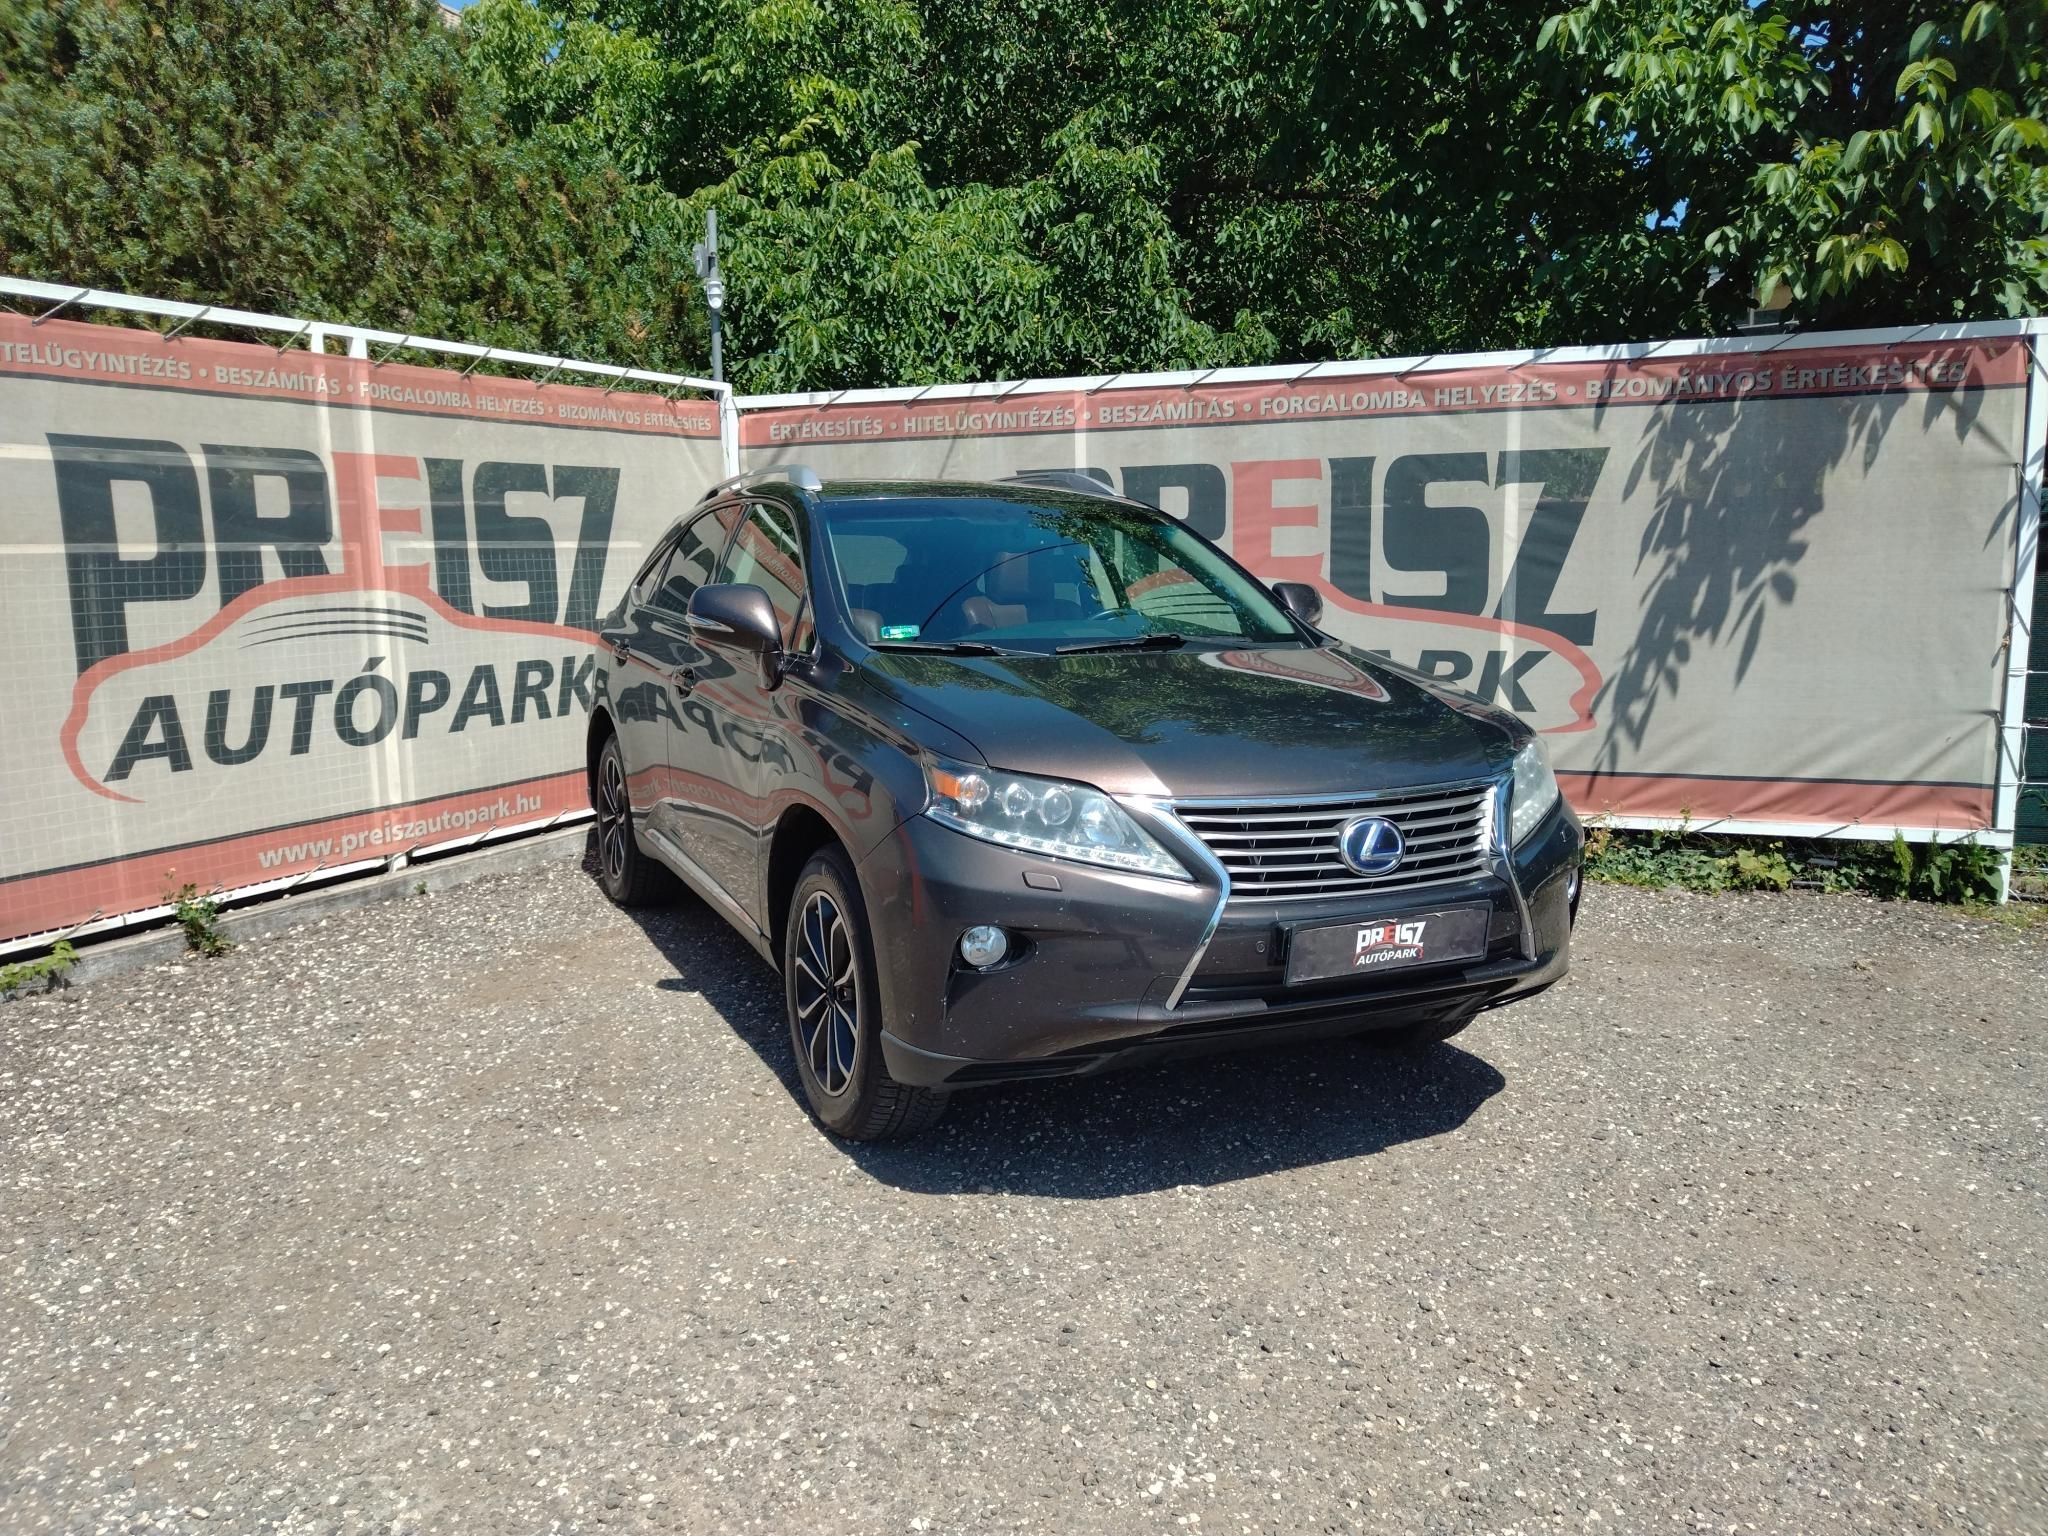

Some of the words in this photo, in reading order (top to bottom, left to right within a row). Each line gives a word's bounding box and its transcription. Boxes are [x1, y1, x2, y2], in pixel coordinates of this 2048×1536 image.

[215, 366, 341, 395] BESZÁMÍTÁS
[359, 381, 472, 409] FORGALOMBA
[476, 396, 545, 416] HELYEZÉS
[558, 405, 641, 426] BIZOMÁNYOS
[770, 413, 884, 442] ÉRTÉKESÍTÉS
[903, 405, 1077, 434] HITELÜGYINTÉZÉS
[1099, 397, 1236, 424] BESZÁMÍTÁS
[1259, 388, 1427, 416] FORGALOMBA
[1434, 378, 1558, 407] HELYEZÉS
[1586, 366, 1773, 400] BIZOMÁNYOS
[1781, 358, 1968, 390] ÉRTÉKESÍTÉS
[45, 432, 622, 676] PREISZ
[102, 653, 595, 783] AUTÓPARK
[258, 792, 542, 869] www.preiszautopark.hu
[1355, 920, 1427, 954] PREISZ
[1356, 947, 1419, 966] AUTÓPARK
